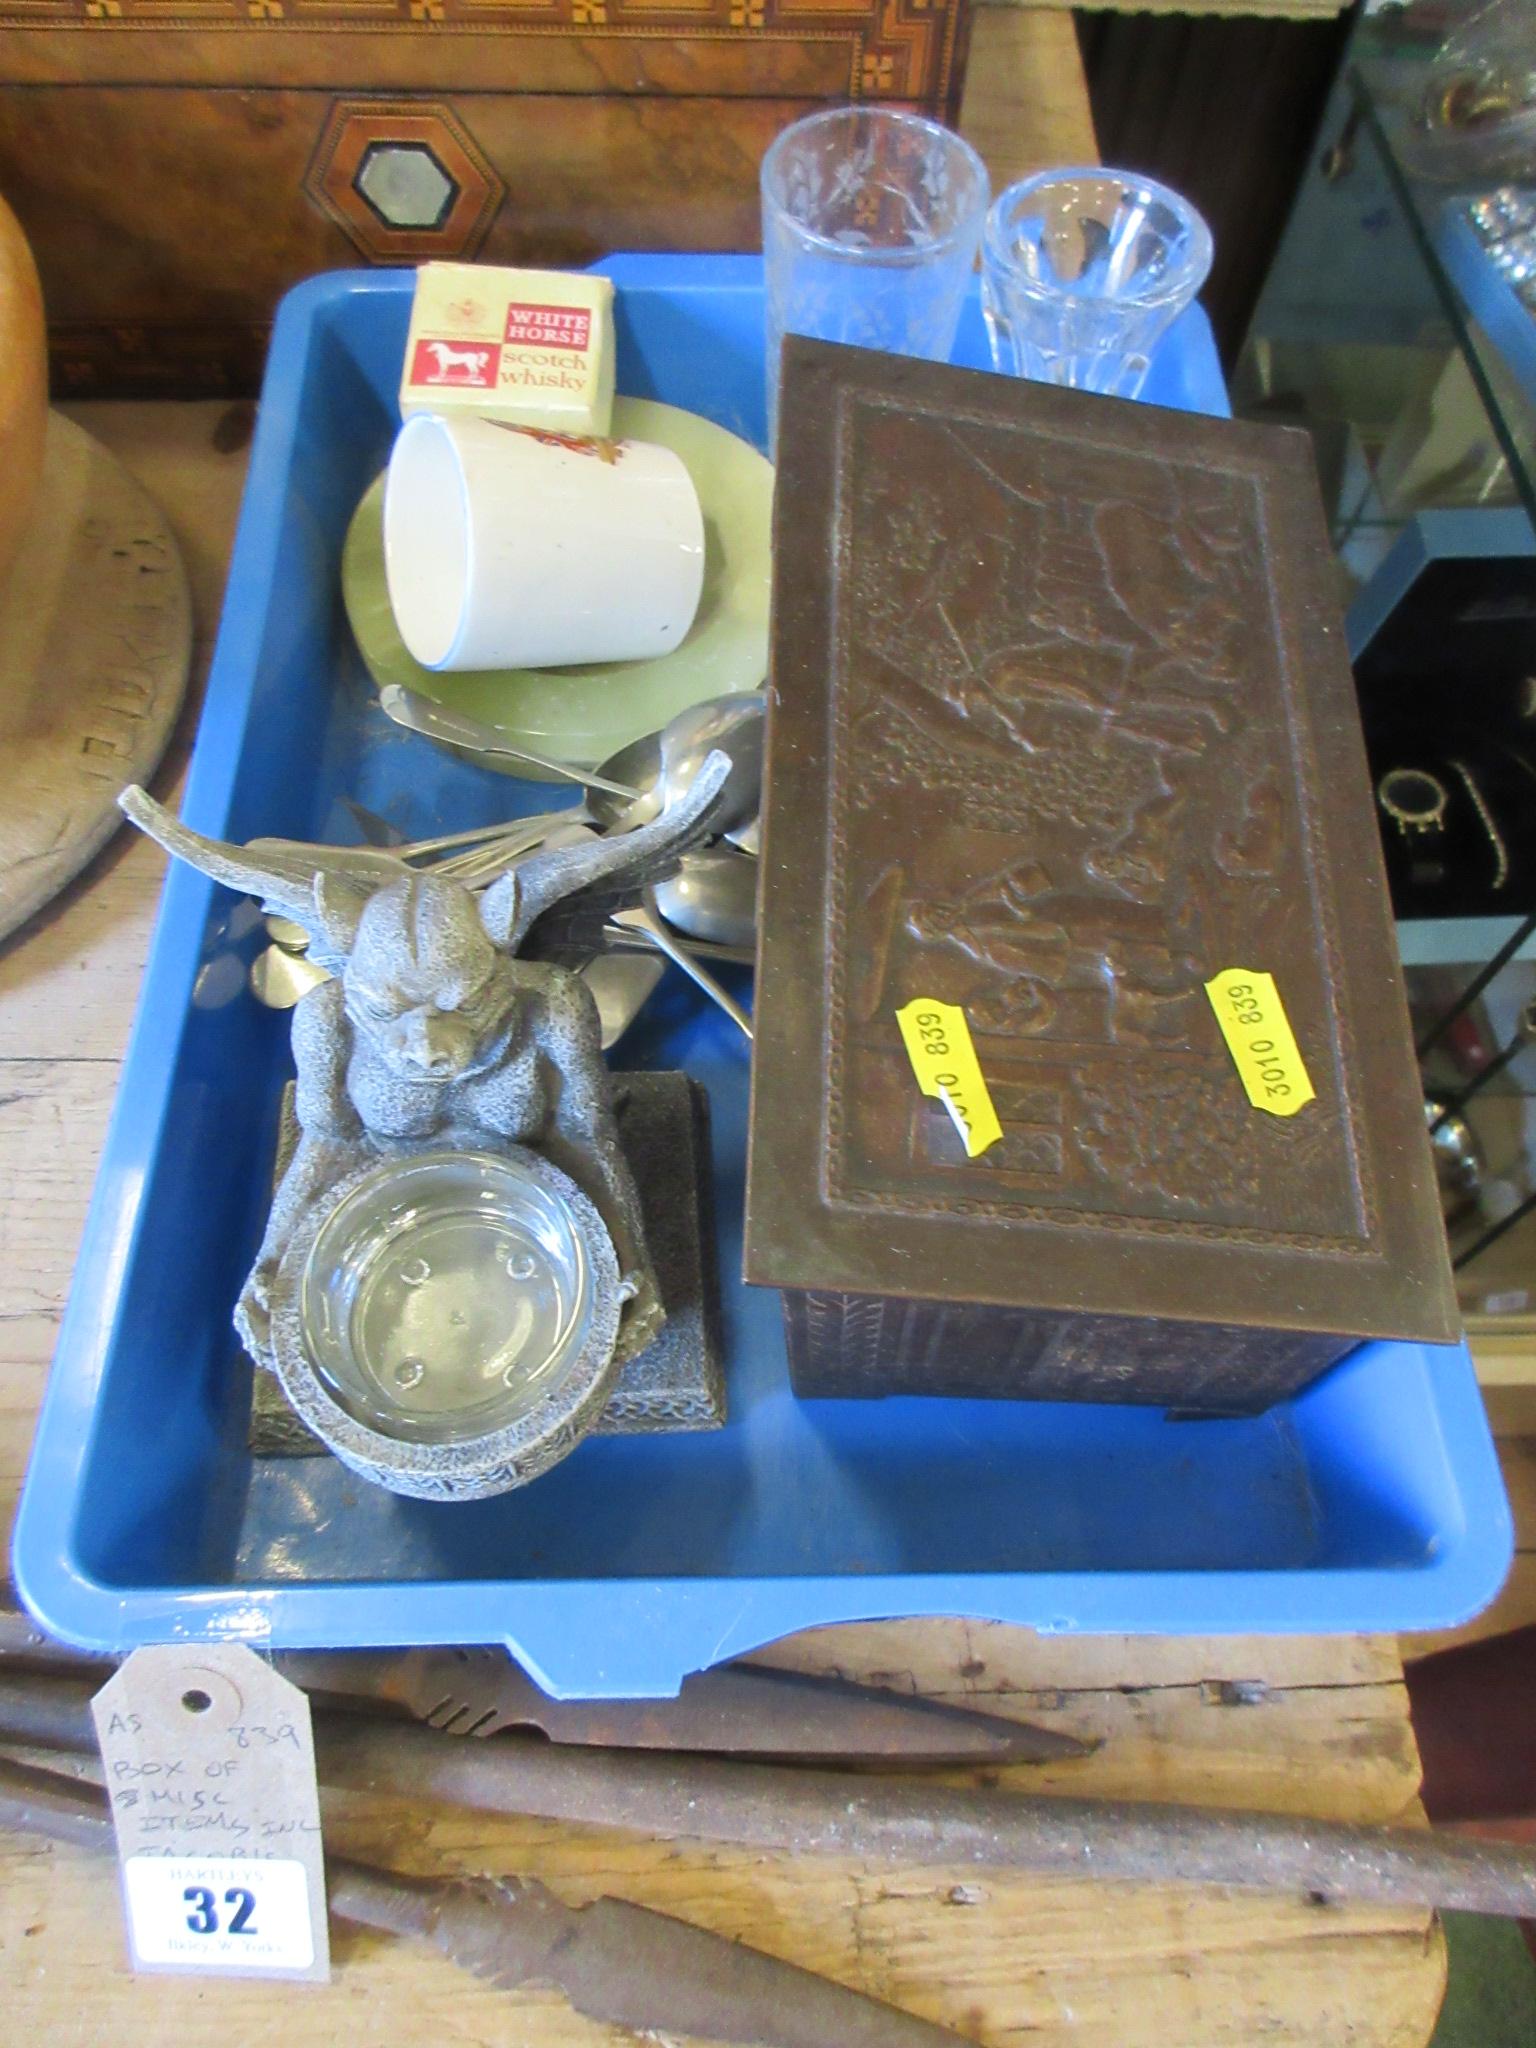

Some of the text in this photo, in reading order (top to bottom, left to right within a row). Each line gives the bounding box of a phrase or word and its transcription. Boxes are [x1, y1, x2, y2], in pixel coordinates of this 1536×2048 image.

[510, 311, 588, 330] WHITE
[509, 326, 586, 345] HORSE
[504, 353, 586, 371] scotch
[501, 370, 586, 391] whisky
[916, 1013, 949, 1056] 839
[1228, 983, 1291, 1098] 3010 839
[113, 1760, 239, 1779] BOX OF
[139, 1812, 249, 1838] ITEMS
[182, 1885, 259, 1935] 32
